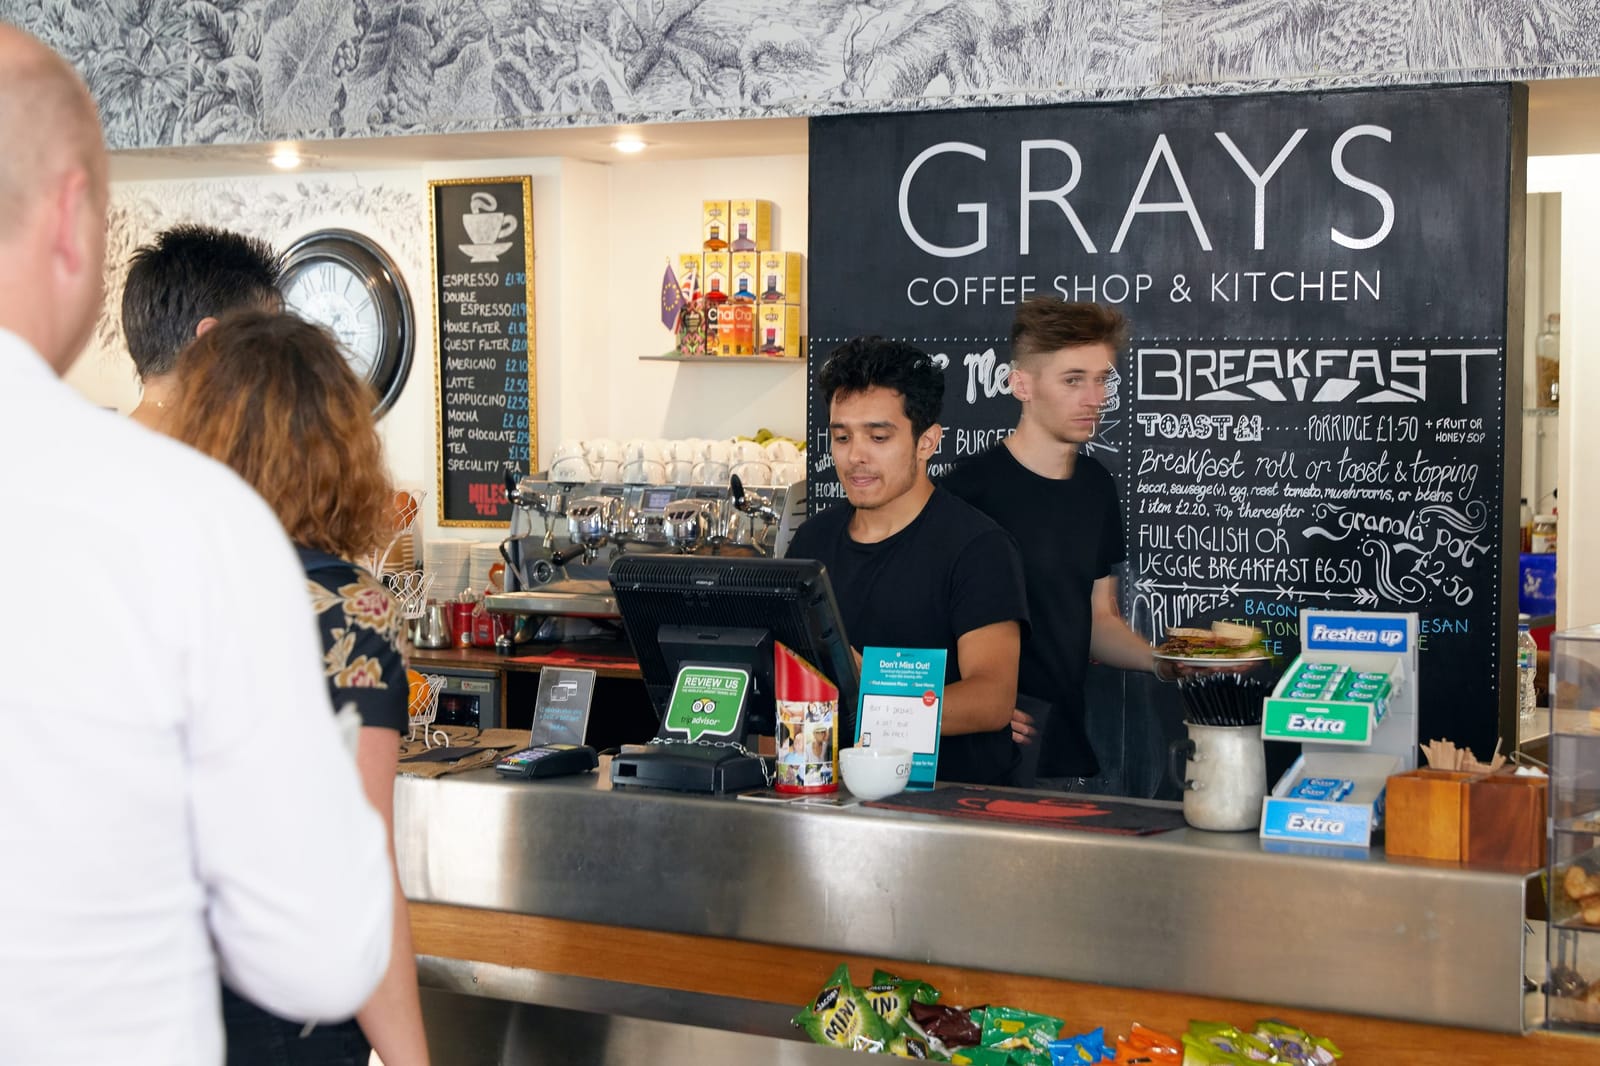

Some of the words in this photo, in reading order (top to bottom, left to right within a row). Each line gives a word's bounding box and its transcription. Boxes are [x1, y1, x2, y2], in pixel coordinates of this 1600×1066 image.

[898, 124, 1395, 257] GRAYS
[442, 273, 499, 287] ESPRESSO
[907, 276, 1036, 306] COFFEE
[1053, 273, 1153, 304] SHOP
[1169, 273, 1192, 303] &
[1211, 270, 1380, 302] KITCHEN
[443, 291, 477, 303] DOUBLE
[460, 303, 512, 317] ESPRESSO
[443, 319, 470, 333] HOUSE
[472, 321, 501, 334] FILTER
[443, 338, 475, 351] GUEST
[479, 338, 510, 351] FILTER
[445, 357, 496, 370] AMERICANO
[446, 377, 475, 389] LATTE
[963, 348, 1012, 404] Me
[1137, 348, 1498, 404] BREAKFAST
[446, 393, 506, 407] CAPPUCCINO
[448, 409, 479, 422] MOCHA
[448, 426, 464, 438] HOT
[468, 427, 516, 442] CHOCOLATE
[1137, 413, 1233, 440] TOAST
[1233, 414, 1262, 441] £1
[1308, 414, 1373, 442] PORRIDGE
[1425, 419, 1433, 429] +
[1435, 418, 1468, 429] FRUIT
[1470, 418, 1483, 430] OR
[1435, 432, 1465, 443] HONEY
[447, 442, 467, 454] TEA
[503, 461, 521, 473] TEA
[1138, 448, 1245, 483] Breakfast
[1255, 451, 1298, 478] roll
[1305, 460, 1331, 481] or
[1337, 446, 1391, 483] toast
[1394, 460, 1407, 482] &
[1409, 449, 1479, 500] topping
[1250, 482, 1279, 496] roast
[1398, 490, 1412, 501] or
[1415, 486, 1453, 503] beans
[1139, 498, 1145, 514] 1
[1148, 498, 1171, 514] item
[1214, 503, 1233, 521] 70p
[1237, 502, 1305, 527] thereafter
[1138, 524, 1173, 549] FULL
[1174, 525, 1249, 553] ENGLISH
[1255, 528, 1290, 555] OR
[1306, 510, 1424, 541] granola
[1410, 528, 1491, 568] pot
[1139, 552, 1205, 579] VEGGIE
[1208, 556, 1309, 583] BREAKFAST
[1315, 557, 1361, 585] £6.50
[1245, 599, 1297, 617] BACON
[1312, 624, 1377, 643] Freshen
[1379, 629, 1403, 646] up
[880, 659, 898, 669] Don't
[684, 676, 722, 688] REVIEW
[725, 680, 739, 689] US
[1287, 714, 1346, 733] Extra
[1286, 814, 1344, 834] Extra
[872, 997, 899, 1016] INI
[825, 998, 856, 1041] MINI
